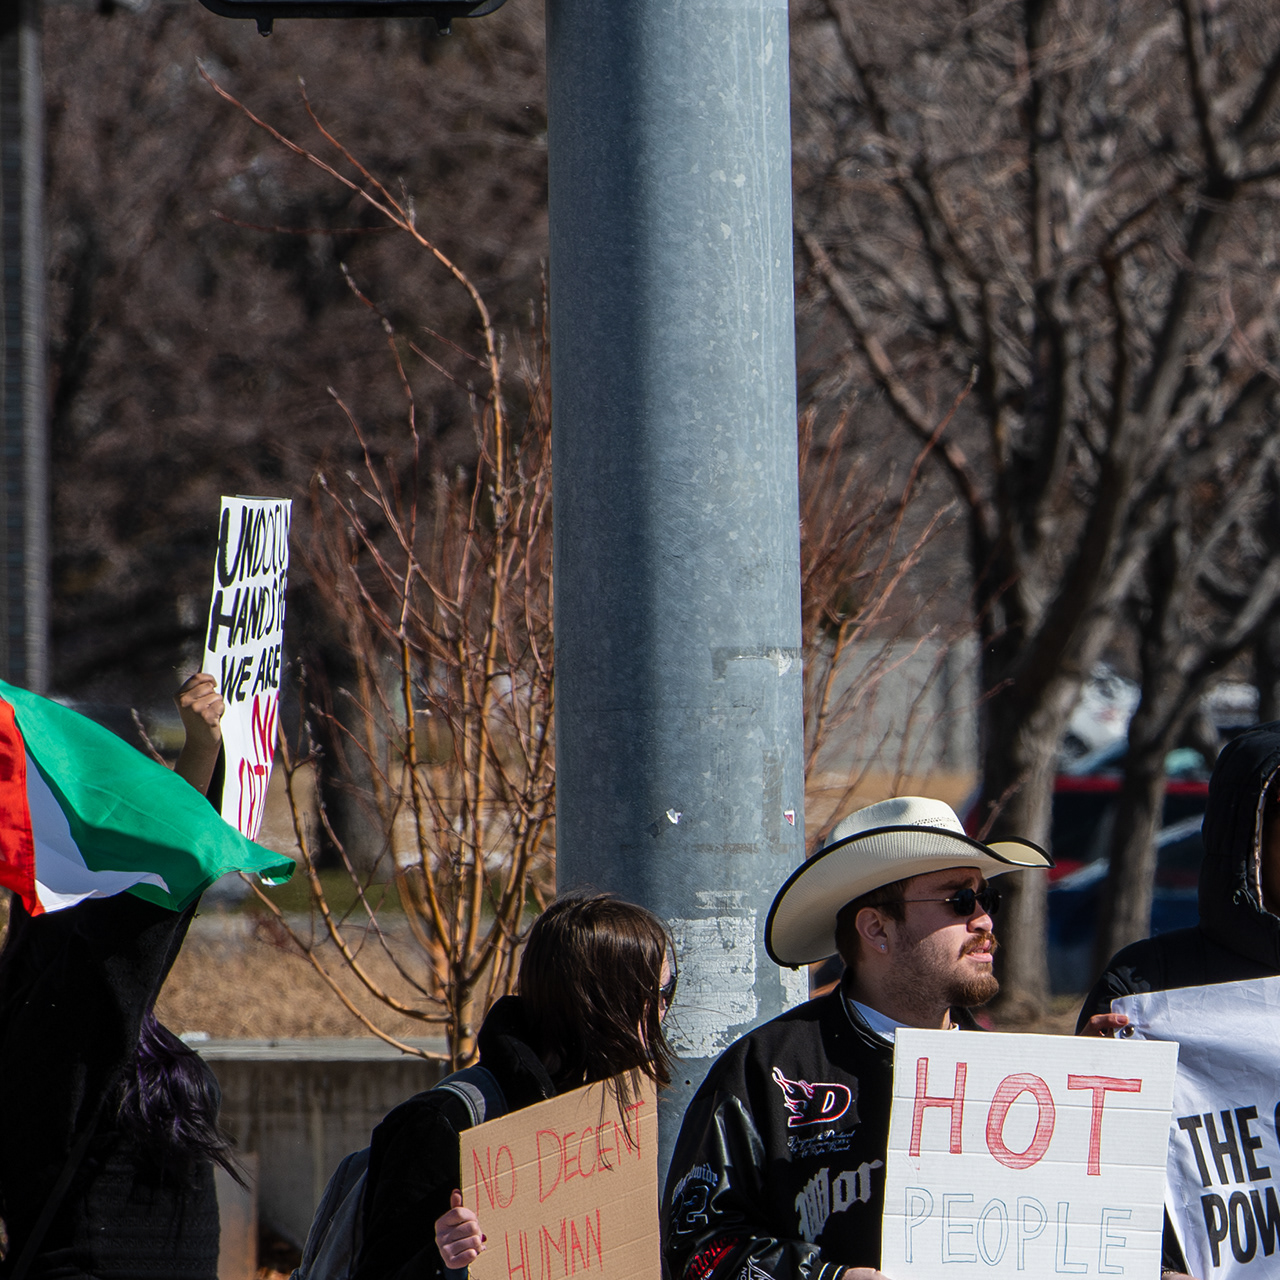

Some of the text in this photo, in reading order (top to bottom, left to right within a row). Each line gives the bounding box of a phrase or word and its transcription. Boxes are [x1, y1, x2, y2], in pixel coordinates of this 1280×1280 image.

[208, 576, 278, 653] HANDS
[221, 644, 281, 706] WE ARE
[472, 1101, 645, 1214] NO DECENT
[908, 1057, 1142, 1176] HOT
[1177, 1105, 1271, 1187] THE
[904, 1186, 1132, 1275] PEOPLE
